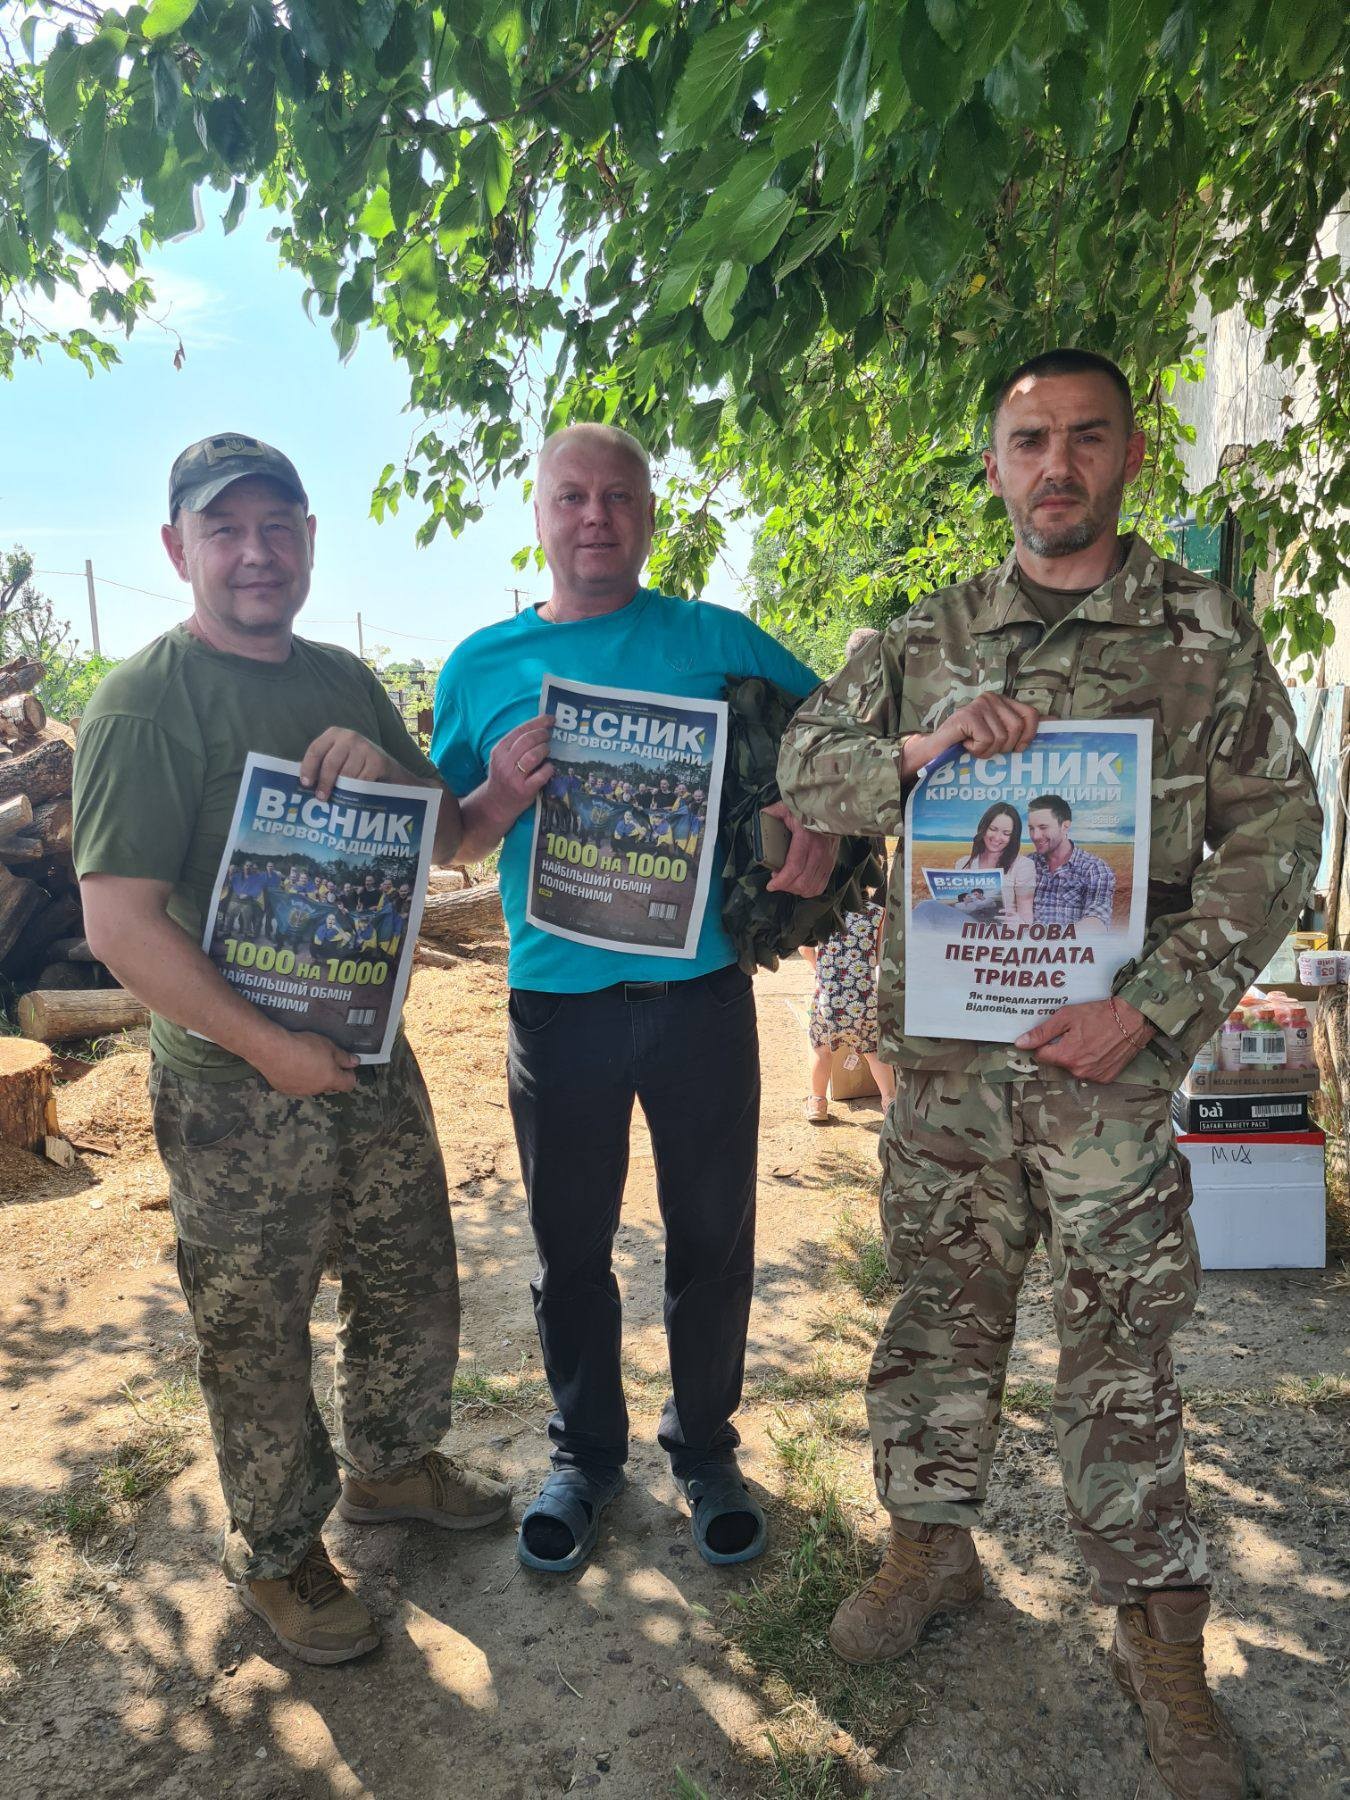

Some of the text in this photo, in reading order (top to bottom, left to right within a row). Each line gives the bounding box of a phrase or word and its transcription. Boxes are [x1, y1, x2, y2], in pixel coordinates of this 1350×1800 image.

[552, 728, 703, 766] КІРОВОГРАДЩИНИ
[252, 818, 410, 858] КІРОВОГРАДЩИНИ
[546, 833, 688, 883] 1000 НА 1000
[540, 873, 613, 904] ПОЛОНЕНИМИ
[542, 859, 652, 895] НАЙБІЛЬШИЙ ОБМІН
[961, 922, 1077, 941] ПІЛЬГОВА
[224, 938, 389, 986] 1000 НА 1000
[945, 943, 1095, 966] ПЕРЕДПЛАТА
[973, 968, 1067, 988] ТРИВАЄ
[310, 986, 352, 1002] ОБМІН
[968, 991, 1069, 1005] Як передплатити?
[965, 1002, 1058, 1016] Відповідь на сто
[1202, 1122, 1223, 1130] SAFARI
[1225, 1121, 1250, 1129] VARIETY
